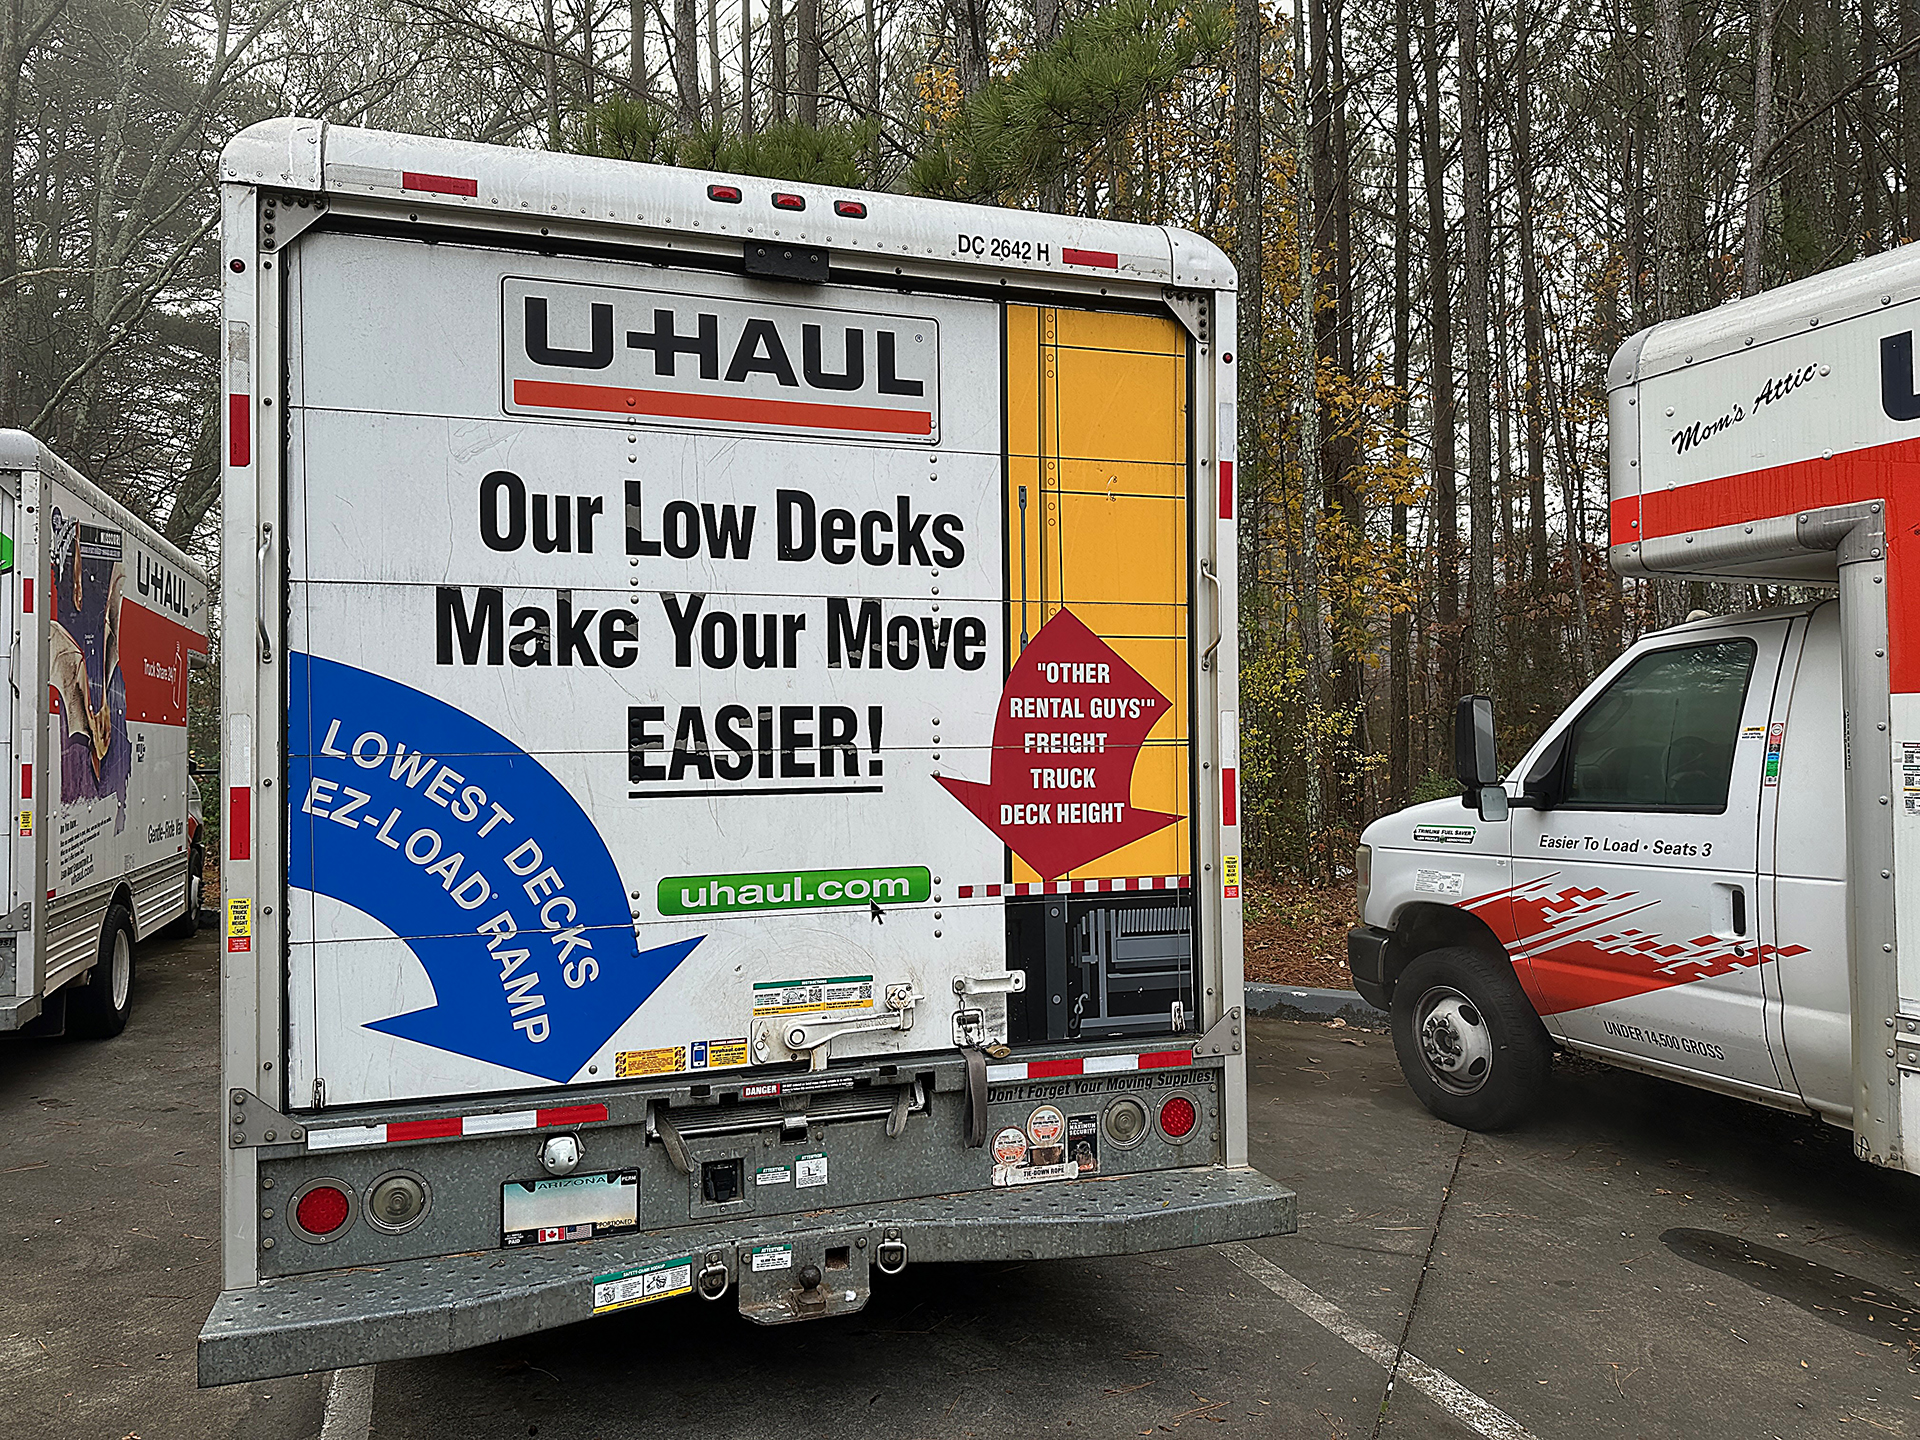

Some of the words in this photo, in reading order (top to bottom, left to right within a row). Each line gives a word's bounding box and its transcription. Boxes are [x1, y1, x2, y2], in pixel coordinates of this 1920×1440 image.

[958, 233, 985, 255] DC
[990, 237, 1032, 260] 2642
[1037, 242, 1049, 262] H
[524, 296, 924, 398] U-HAUL
[1671, 404, 1746, 455] Mom's
[1752, 363, 1817, 415] Attic
[479, 469, 603, 554] Our
[624, 479, 757, 561] Low
[776, 488, 965, 569] Decks
[435, 586, 639, 669] Make
[659, 591, 806, 670] Your
[827, 596, 987, 672] Move
[143, 657, 156, 676] Truck
[1037, 662, 1111, 684] "OTHER
[1010, 698, 1084, 719] RENTAL
[627, 705, 884, 783] EASIER!
[1024, 732, 1108, 754] FREIGHT
[1030, 768, 1097, 790] TRUCK
[1000, 803, 1052, 826] DECK
[1056, 802, 1125, 824] HEIGHT
[319, 718, 515, 839] LOWEST
[502, 838, 600, 990] DECKS
[1539, 834, 1580, 850] Easier
[1583, 836, 1600, 851] To
[1603, 838, 1640, 853] Load
[1653, 840, 1698, 857] Seats
[1701, 842, 1713, 857] 3
[681, 876, 910, 908] uhaul.com
[301, 776, 492, 911] EZ-LOAD
[476, 910, 552, 1044] RAMP
[1603, 1020, 1645, 1042] UNDER
[1644, 1030, 1681, 1051] 14,500
[1681, 1037, 1725, 1061] GROSS
[745, 1085, 778, 1096] DANGER
[987, 1086, 1025, 1102] Don't
[1027, 1083, 1071, 1101] Forget
[1073, 1080, 1104, 1096] Your
[1106, 1076, 1152, 1093] Moving
[1156, 1070, 1216, 1089] Supplies!
[538, 1176, 606, 1190] ARIZONA
